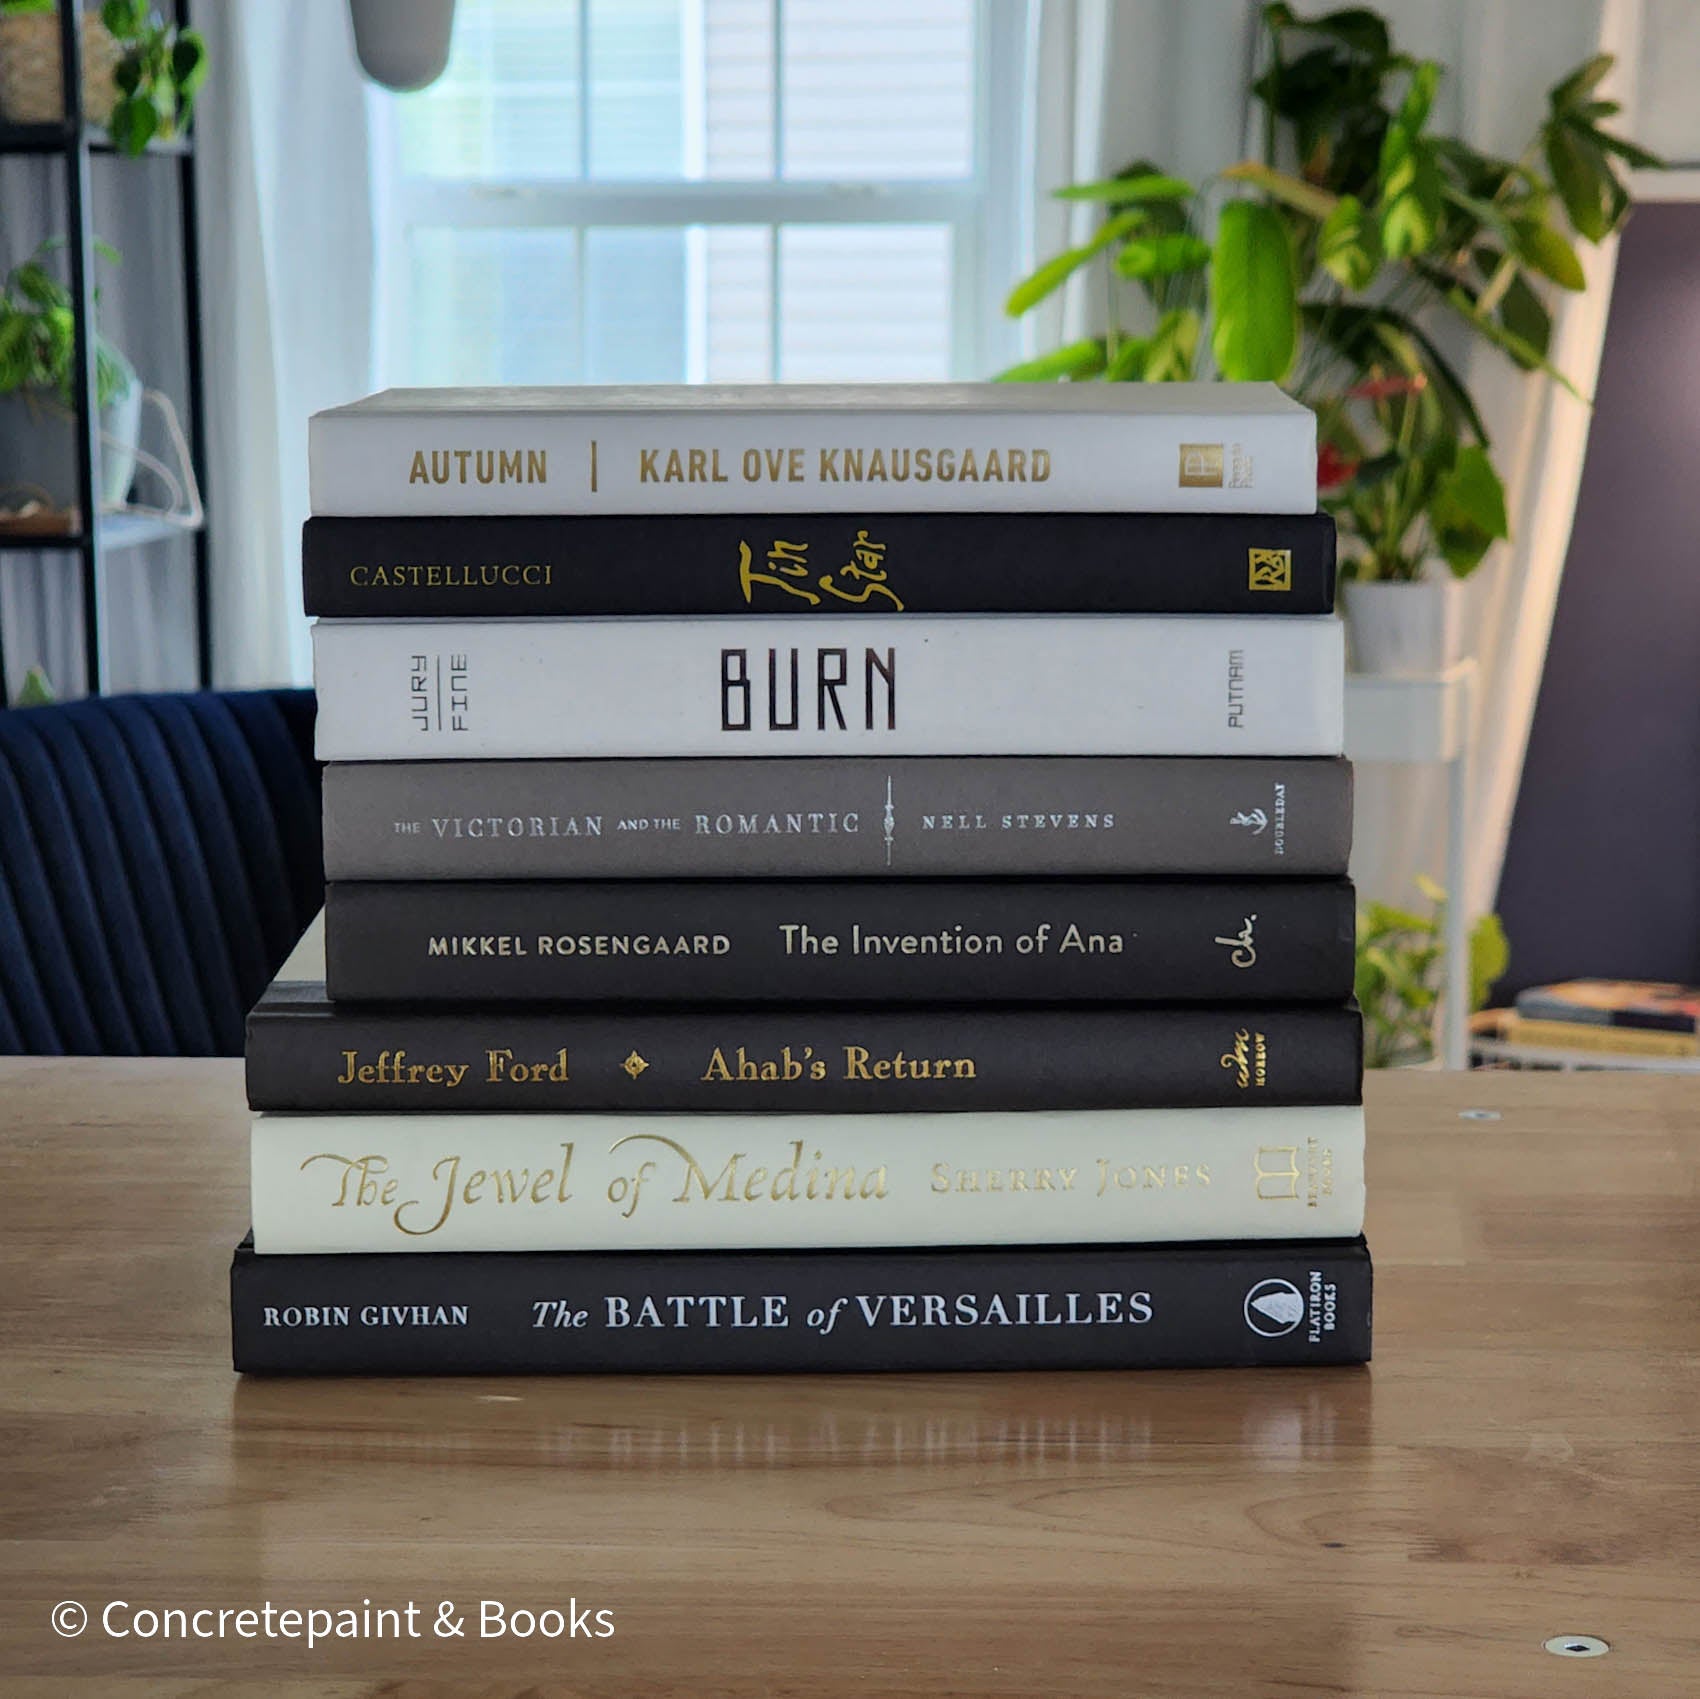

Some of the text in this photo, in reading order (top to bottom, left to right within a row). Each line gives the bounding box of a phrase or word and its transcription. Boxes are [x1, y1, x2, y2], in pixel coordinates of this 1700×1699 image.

[409, 449, 547, 485] AUTUMN
[640, 448, 1050, 484] KARL OVE KNAUSGAARD
[350, 564, 552, 586] CASTELLUCCI
[739, 540, 821, 606] Tin
[817, 529, 905, 612] Star
[411, 655, 429, 732] JURY
[450, 655, 469, 732] FINE
[720, 647, 896, 732] BURN
[1227, 648, 1245, 730] PUTNAM
[393, 812, 859, 838] THE VICTORIAN AND THE ROMANTIC
[922, 814, 1114, 829] NELL STEVENS
[1274, 782, 1286, 857] DOUBLEDAY
[428, 935, 730, 956] MIKKEL ROSENGAARD
[778, 923, 1123, 955] The Invention of Ana
[337, 1047, 569, 1087] Jeffrey Ford
[843, 1046, 977, 1080] Return
[1255, 1033, 1267, 1086] MORROW
[299, 1133, 889, 1236] The Jewel of Medina
[263, 1305, 468, 1327] ROBIN GIVHAN
[532, 1291, 1153, 1335] The BATTLE of VERSAILLES
[1308, 1271, 1322, 1343] FLATIRON
[1323, 1283, 1338, 1332] BOOKS
